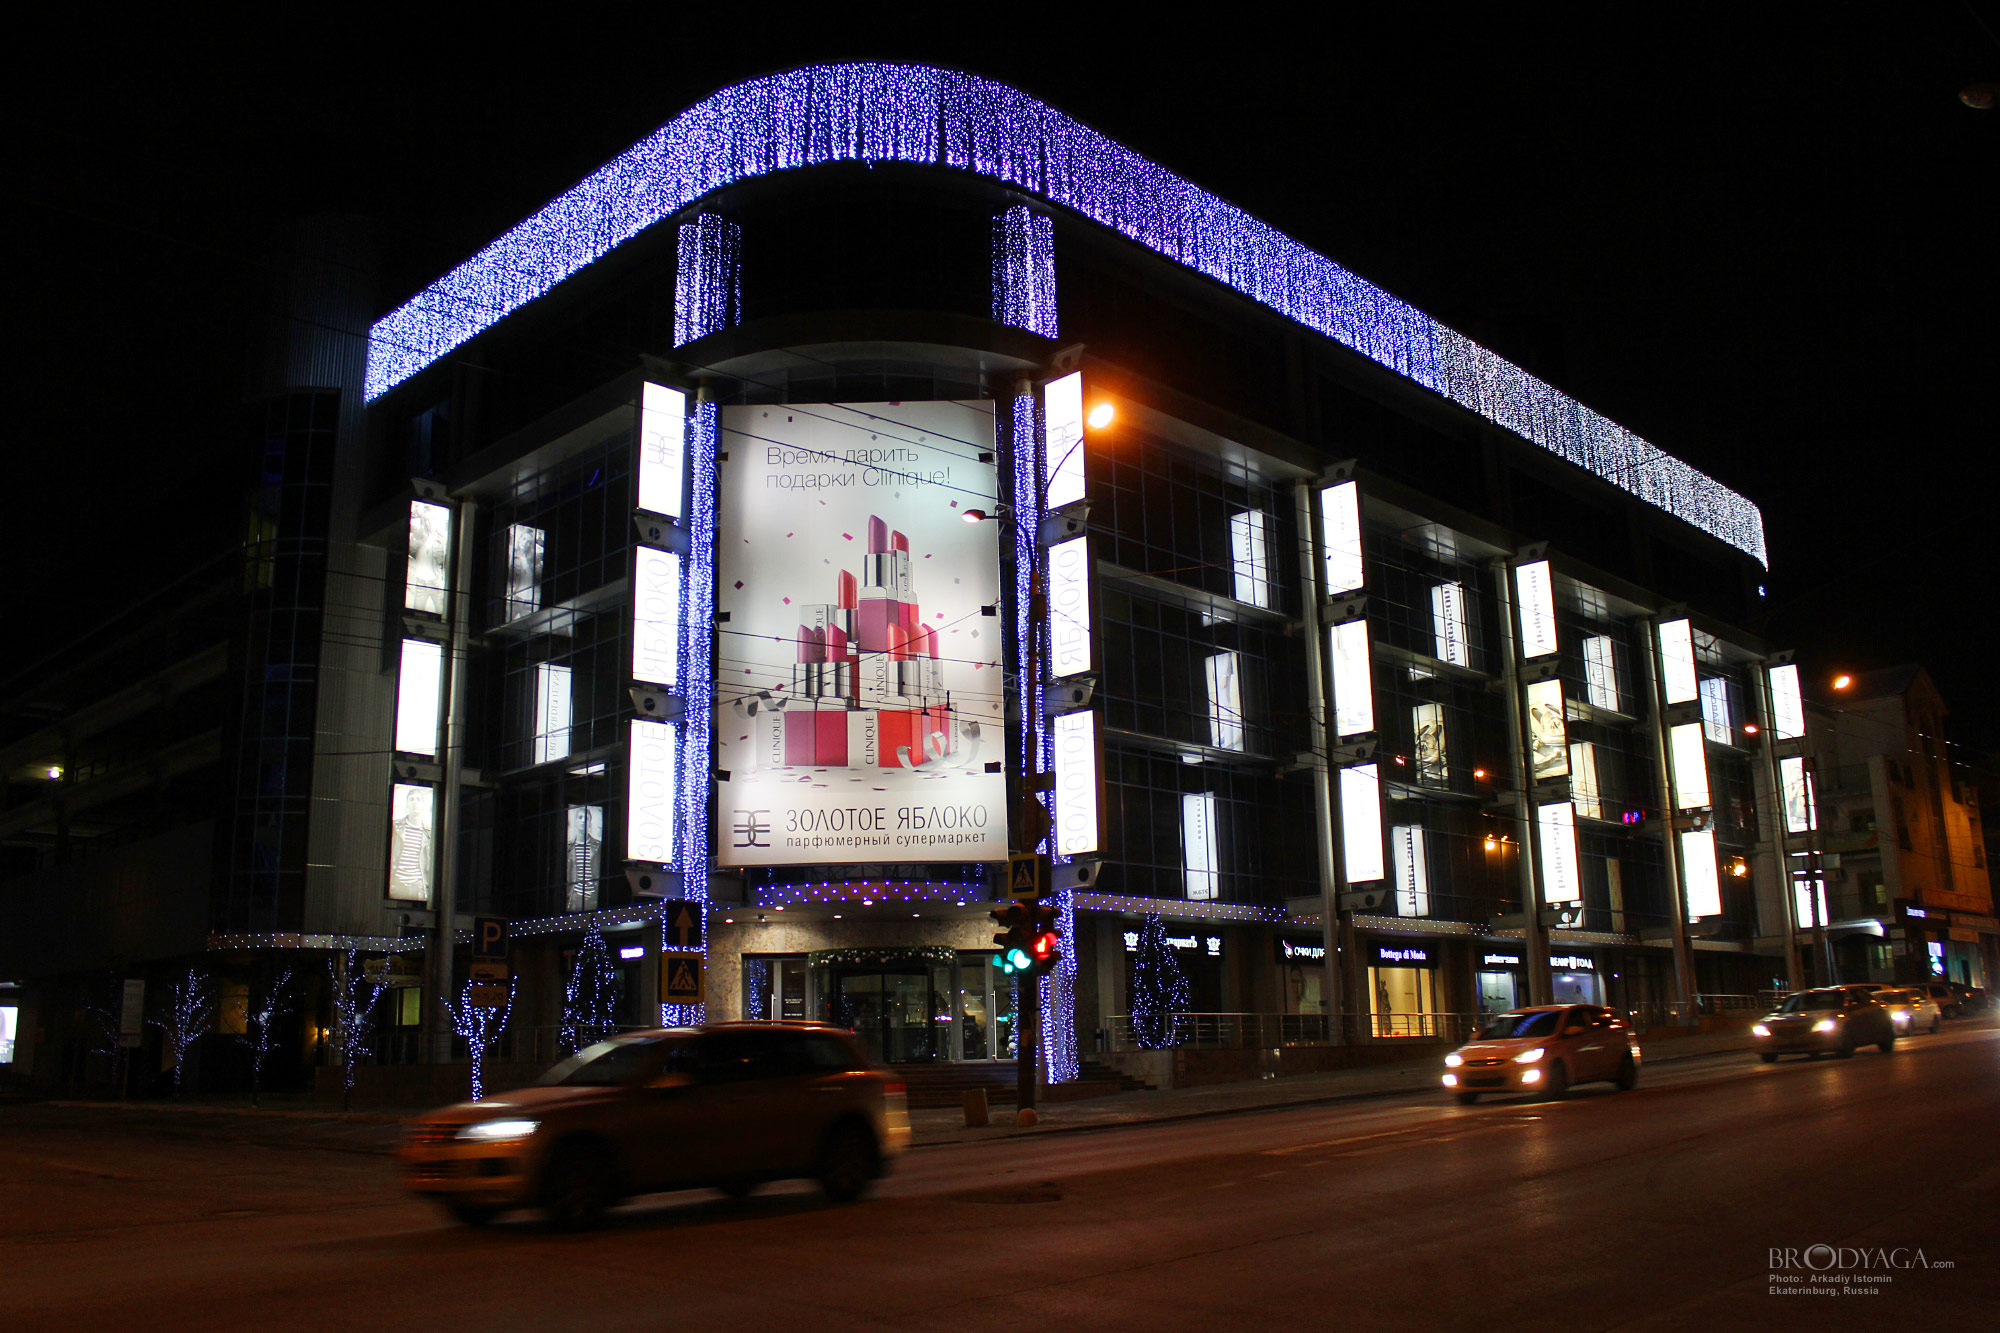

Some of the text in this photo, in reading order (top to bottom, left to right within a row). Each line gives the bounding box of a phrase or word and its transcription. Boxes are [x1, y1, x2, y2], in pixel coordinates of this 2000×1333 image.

[767, 446, 918, 468] Время дарить
[767, 466, 950, 491] подарки Clinique!
[643, 558, 671, 677] ЯБЛОКО
[1058, 549, 1083, 666] ЯБЛОКО
[772, 715, 782, 764] CLINIQUE
[865, 715, 875, 765] CLINIQUE
[637, 724, 667, 859] ЗОЛОТОЕ
[1063, 715, 1089, 850] ЗОЛОТОЕ
[786, 805, 988, 832] ЗОЛОТОЕ ЯБЛОКО
[786, 832, 986, 849] парфюмерный супермаркет
[1294, 946, 1312, 957] ОЧКИ
[1380, 948, 1427, 962] Bottega di Moda
